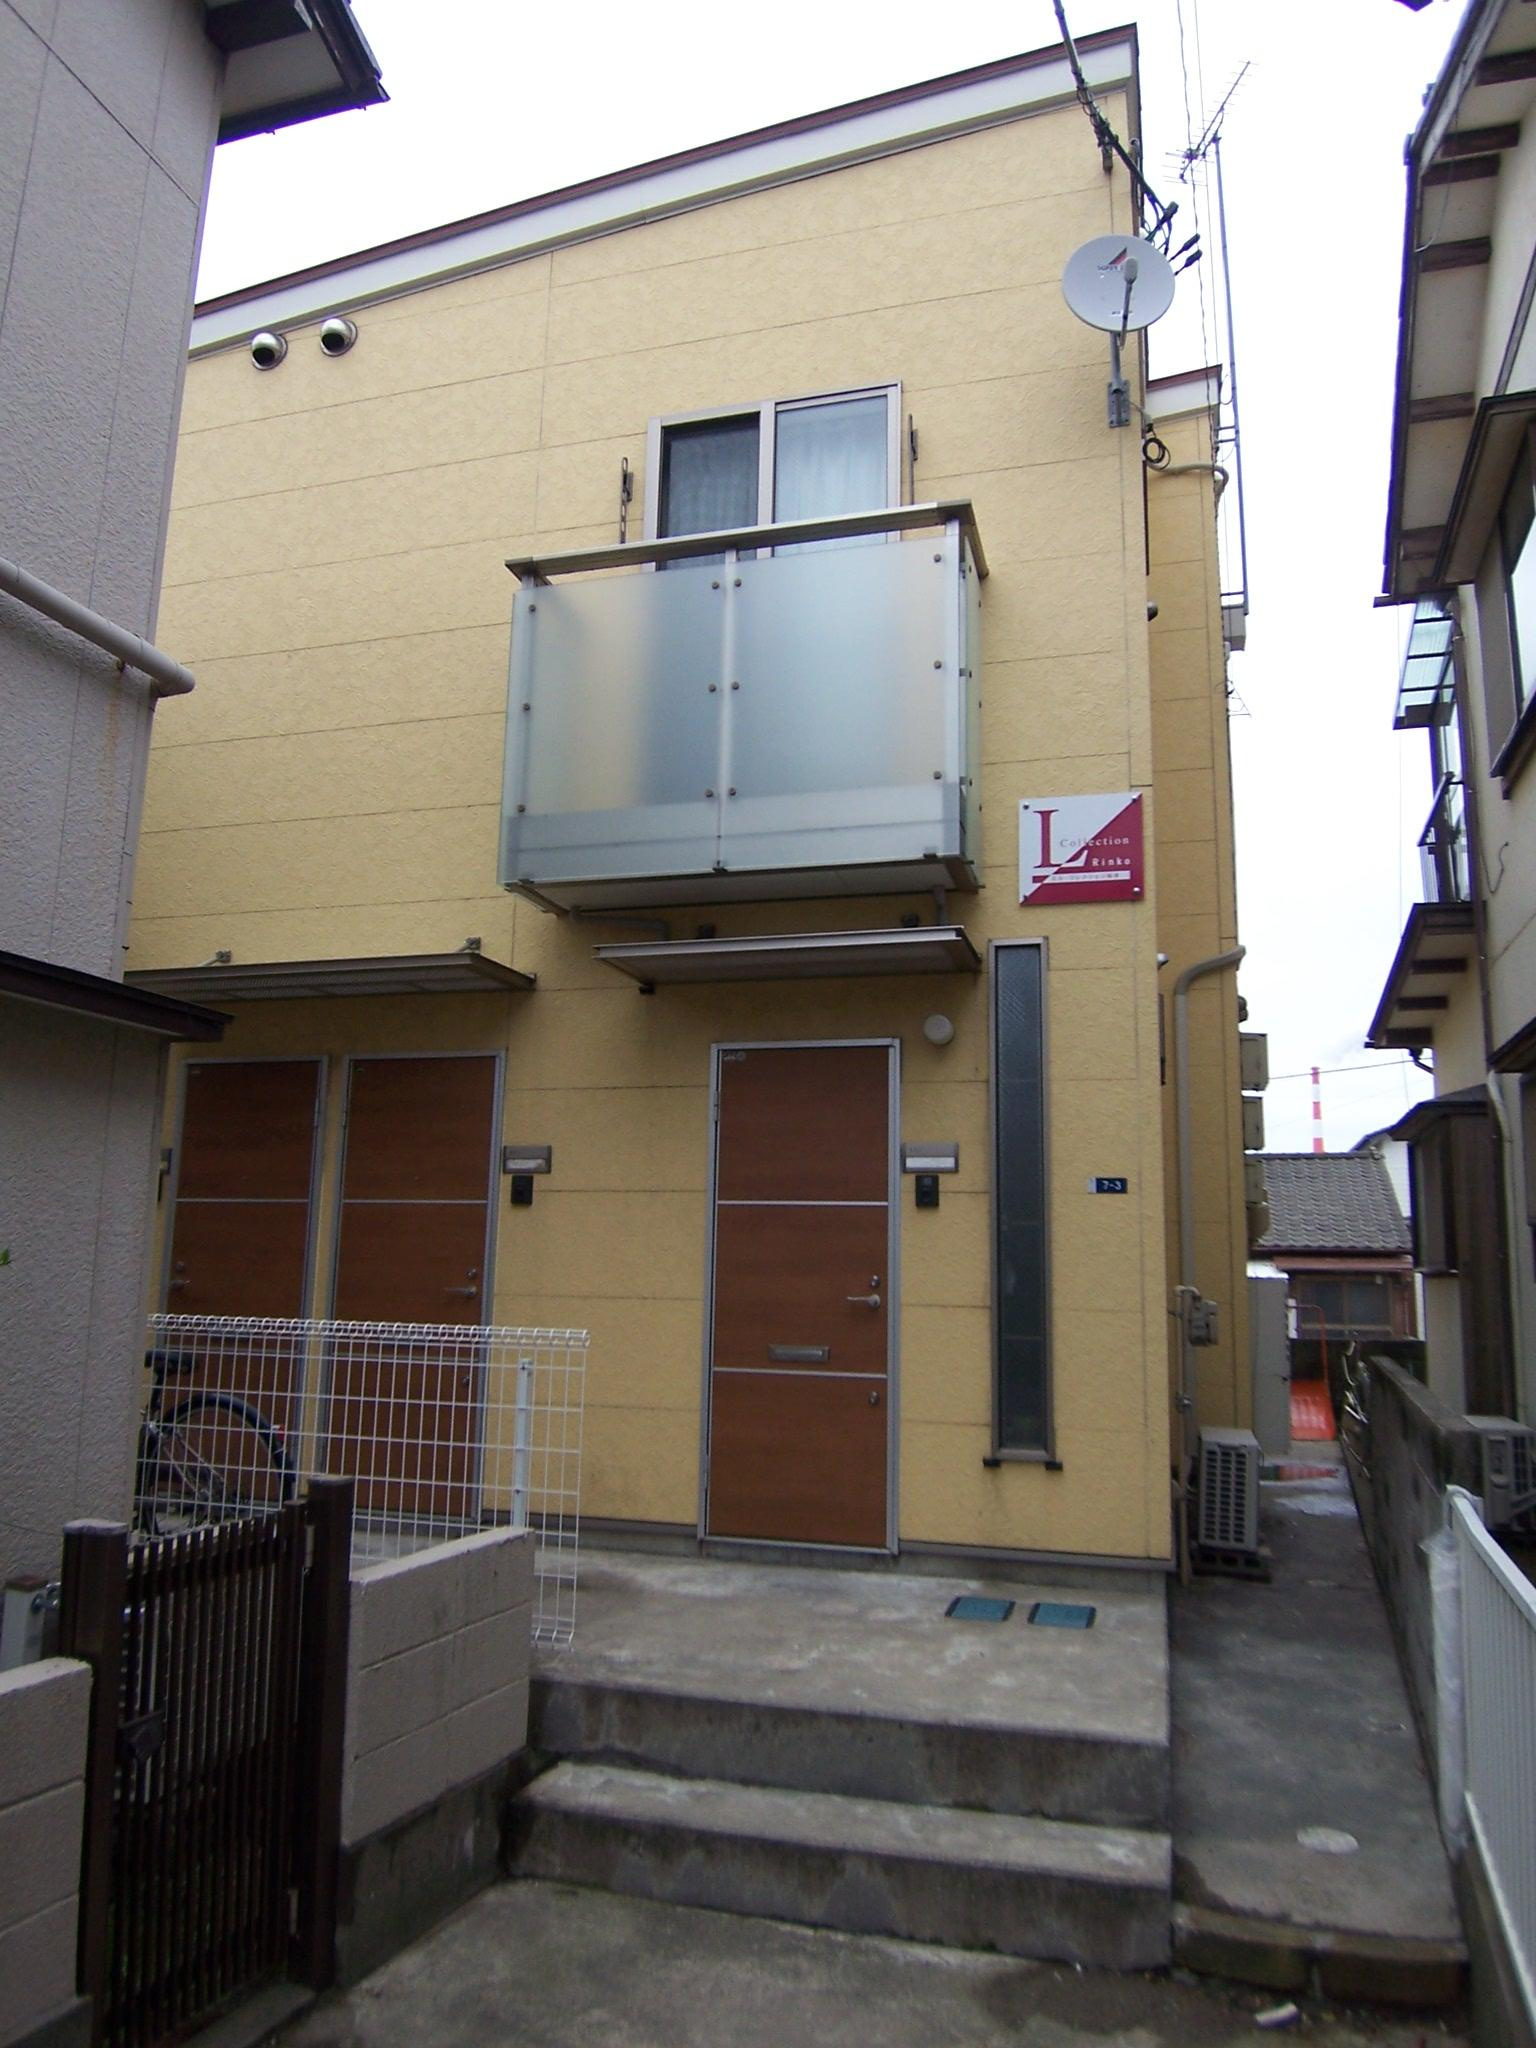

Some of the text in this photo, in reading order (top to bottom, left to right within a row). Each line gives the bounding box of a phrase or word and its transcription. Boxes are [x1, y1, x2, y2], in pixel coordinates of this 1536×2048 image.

[1033, 809, 1088, 868] L
[1060, 836, 1130, 847] Collection
[1092, 856, 1131, 866] Rinko
